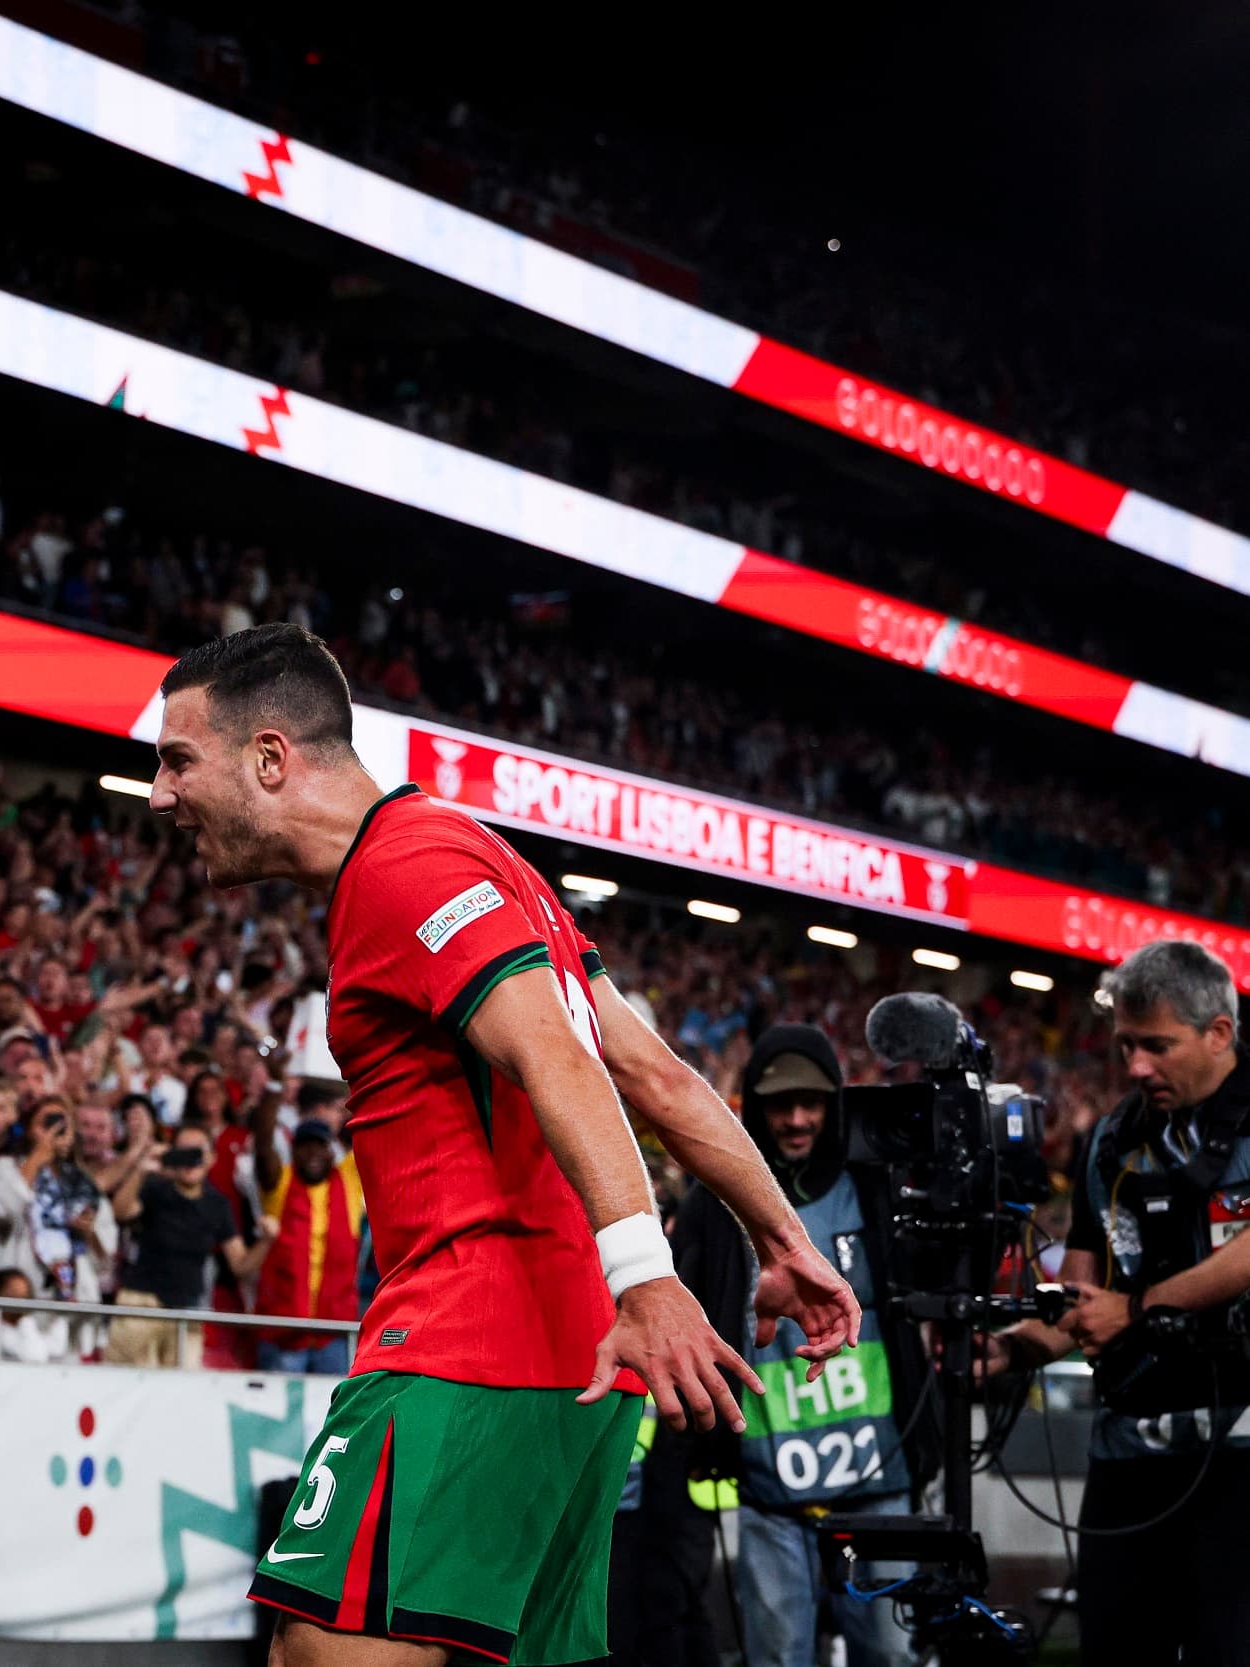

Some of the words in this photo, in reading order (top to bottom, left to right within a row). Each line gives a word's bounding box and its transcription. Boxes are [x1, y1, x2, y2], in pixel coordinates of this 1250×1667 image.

[492, 753, 621, 838] SPORT
[620, 786, 746, 868] LISBOA
[749, 819, 769, 872] E
[771, 823, 906, 907] BENFICA
[424, 888, 497, 945] FOUNDATION
[783, 1355, 868, 1421] HB
[293, 1434, 350, 1530] 5
[776, 1424, 885, 1491] 022
